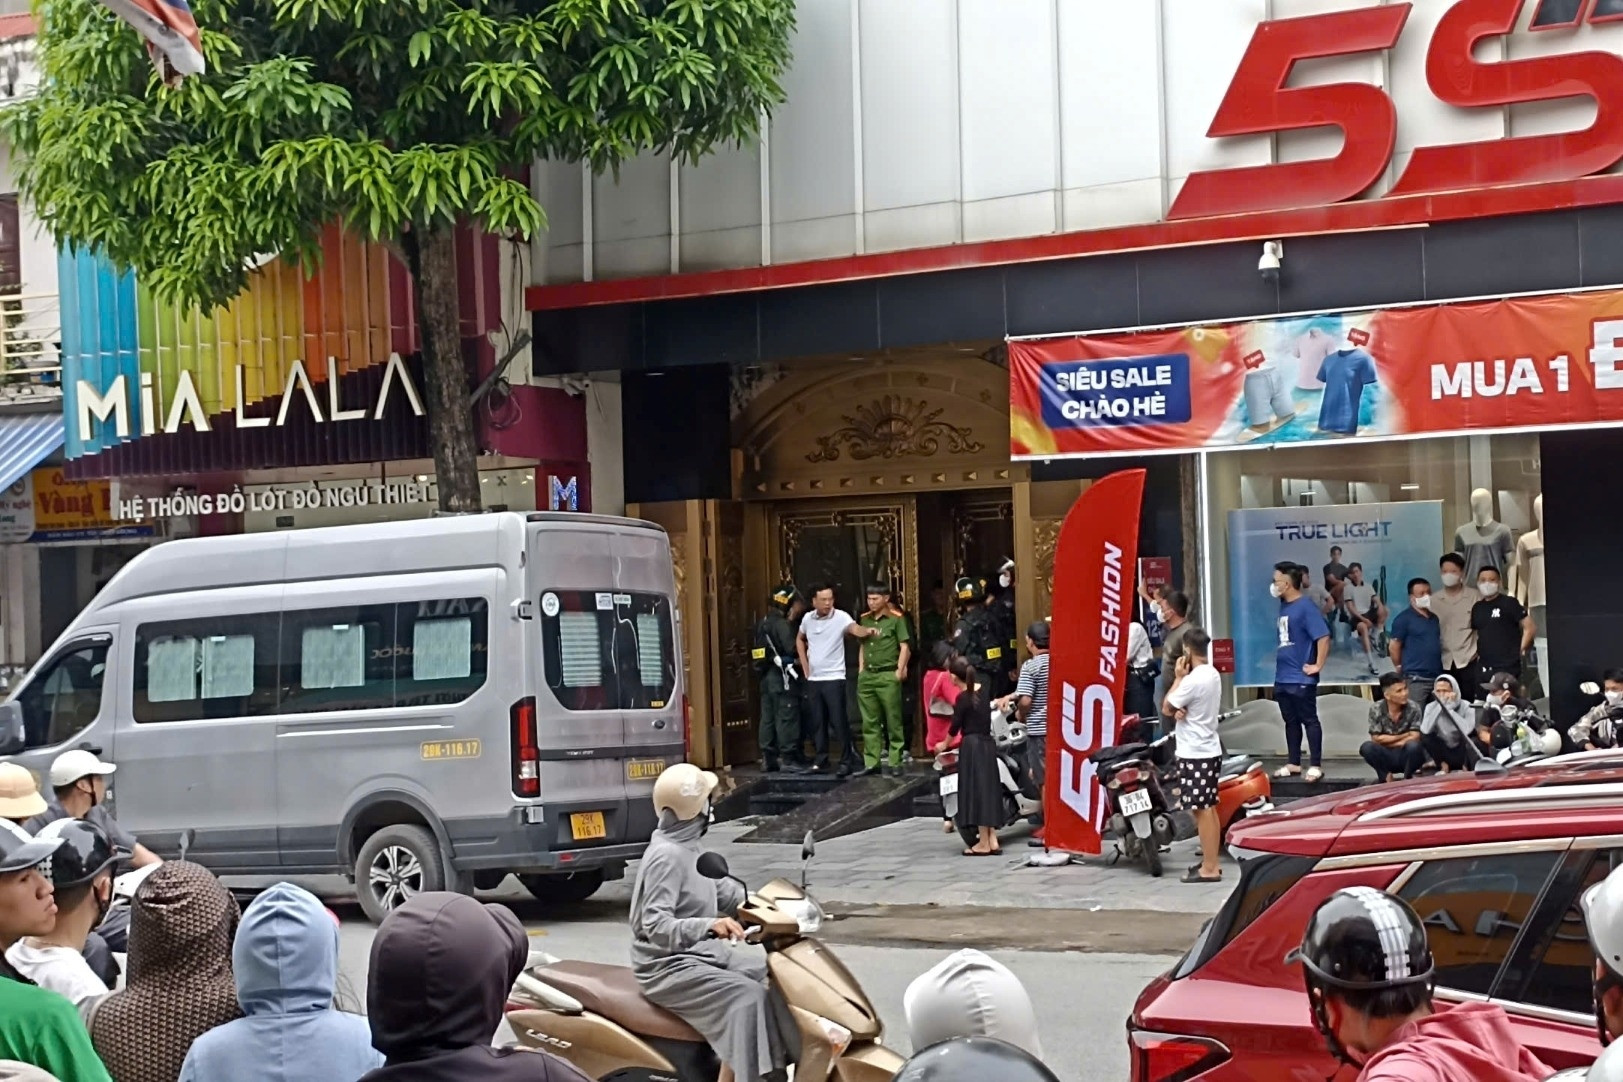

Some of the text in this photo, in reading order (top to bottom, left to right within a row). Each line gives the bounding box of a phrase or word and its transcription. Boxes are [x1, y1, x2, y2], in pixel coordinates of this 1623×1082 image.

[235, 352, 426, 428] LALA
[1056, 365, 1171, 391] SIÊU SALE
[1431, 358, 1544, 400] MUA
[1548, 355, 1569, 392] 1
[1062, 391, 1166, 419] CHÀO HÈ
[120, 494, 145, 523] HỆ
[148, 487, 213, 517] THỐNG
[216, 484, 245, 513] ĐỒ
[548, 475, 577, 510] M
[1275, 521, 1393, 541] TRUE LIGHT
[1099, 541, 1123, 684] FASHION
[525, 1029, 572, 1048] LEAD
